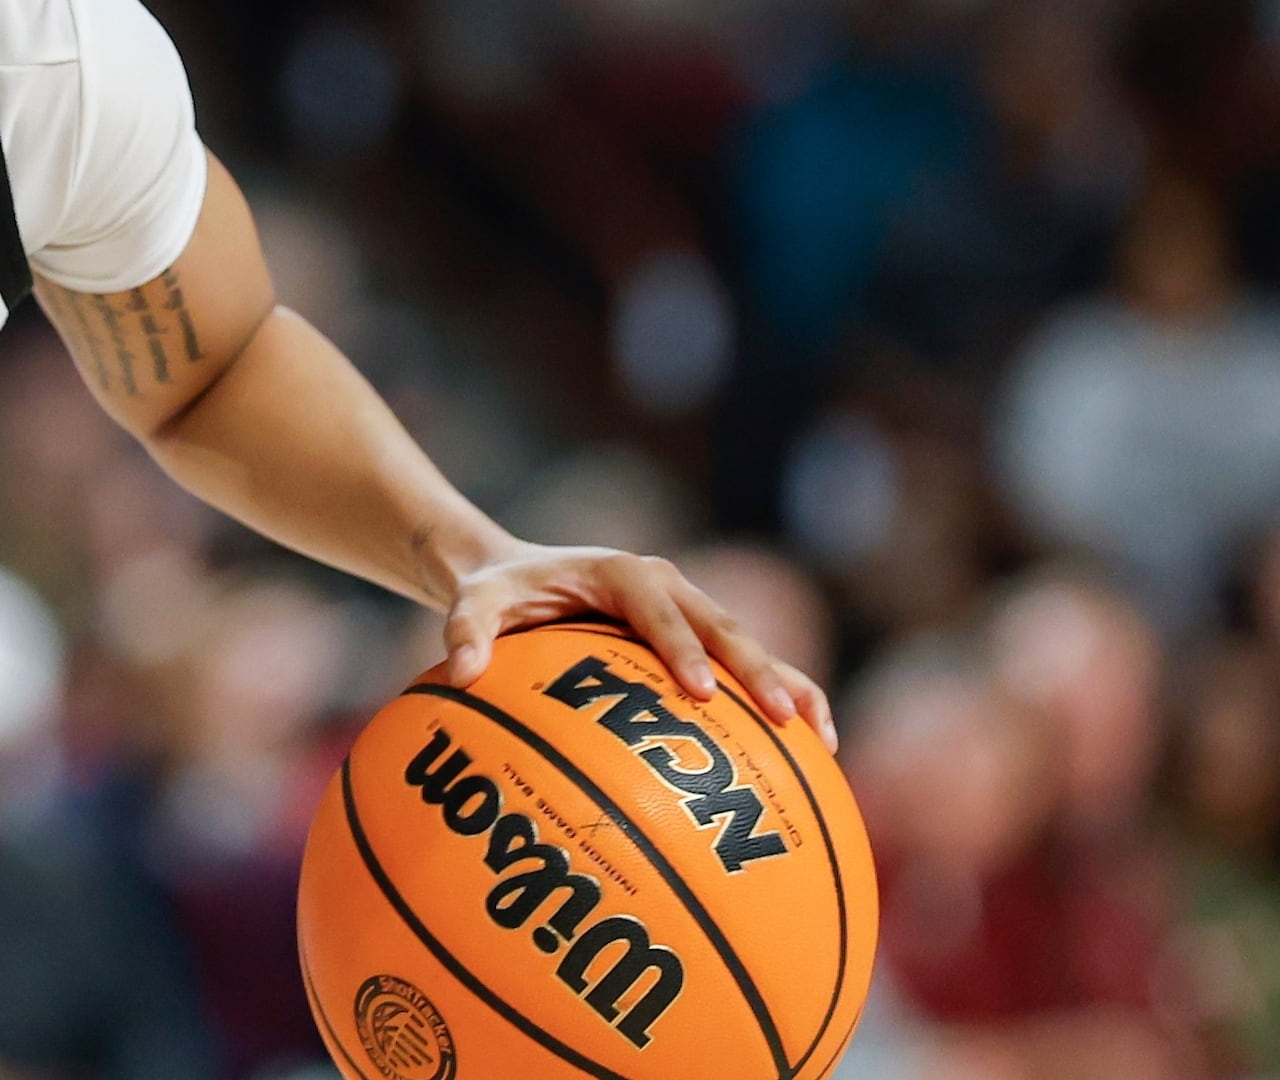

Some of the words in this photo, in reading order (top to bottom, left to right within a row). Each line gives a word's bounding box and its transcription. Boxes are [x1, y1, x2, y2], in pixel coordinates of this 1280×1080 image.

[607, 649, 665, 684] BALL
[502, 763, 535, 798] BALL
[542, 655, 791, 876] NCAA
[536, 797, 577, 839] GAME
[735, 742, 803, 849] OFFICIAL
[403, 727, 685, 1051] Wilson
[578, 839, 637, 897] INDOOR
